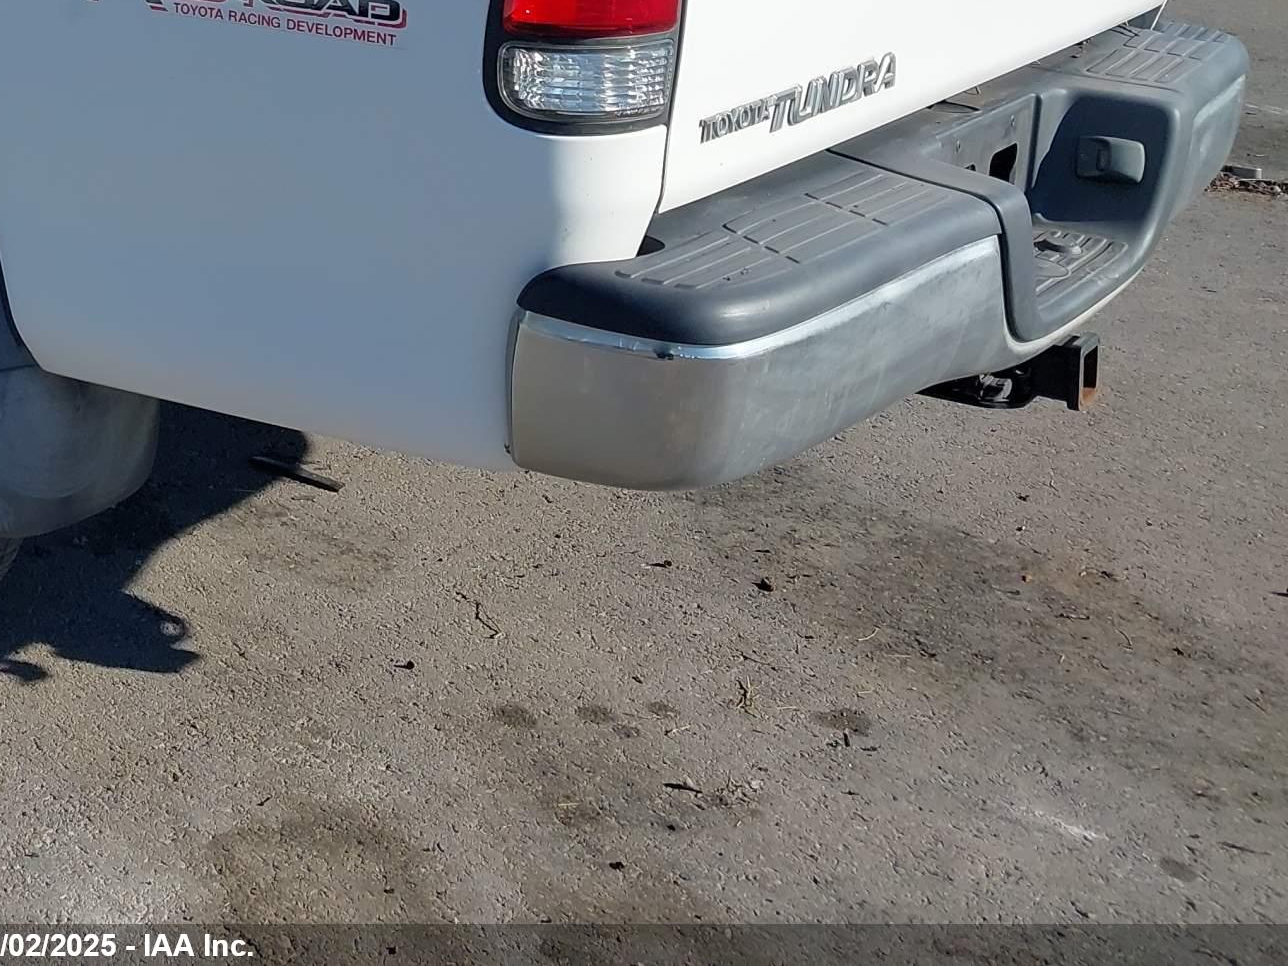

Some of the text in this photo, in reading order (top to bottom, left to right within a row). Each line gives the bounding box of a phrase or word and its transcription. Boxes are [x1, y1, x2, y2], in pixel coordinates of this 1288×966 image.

[173, 2, 397, 47] TOYOTA RACING DEVELOPMENT
[698, 51, 897, 144] TOYOTA TUNDRA
